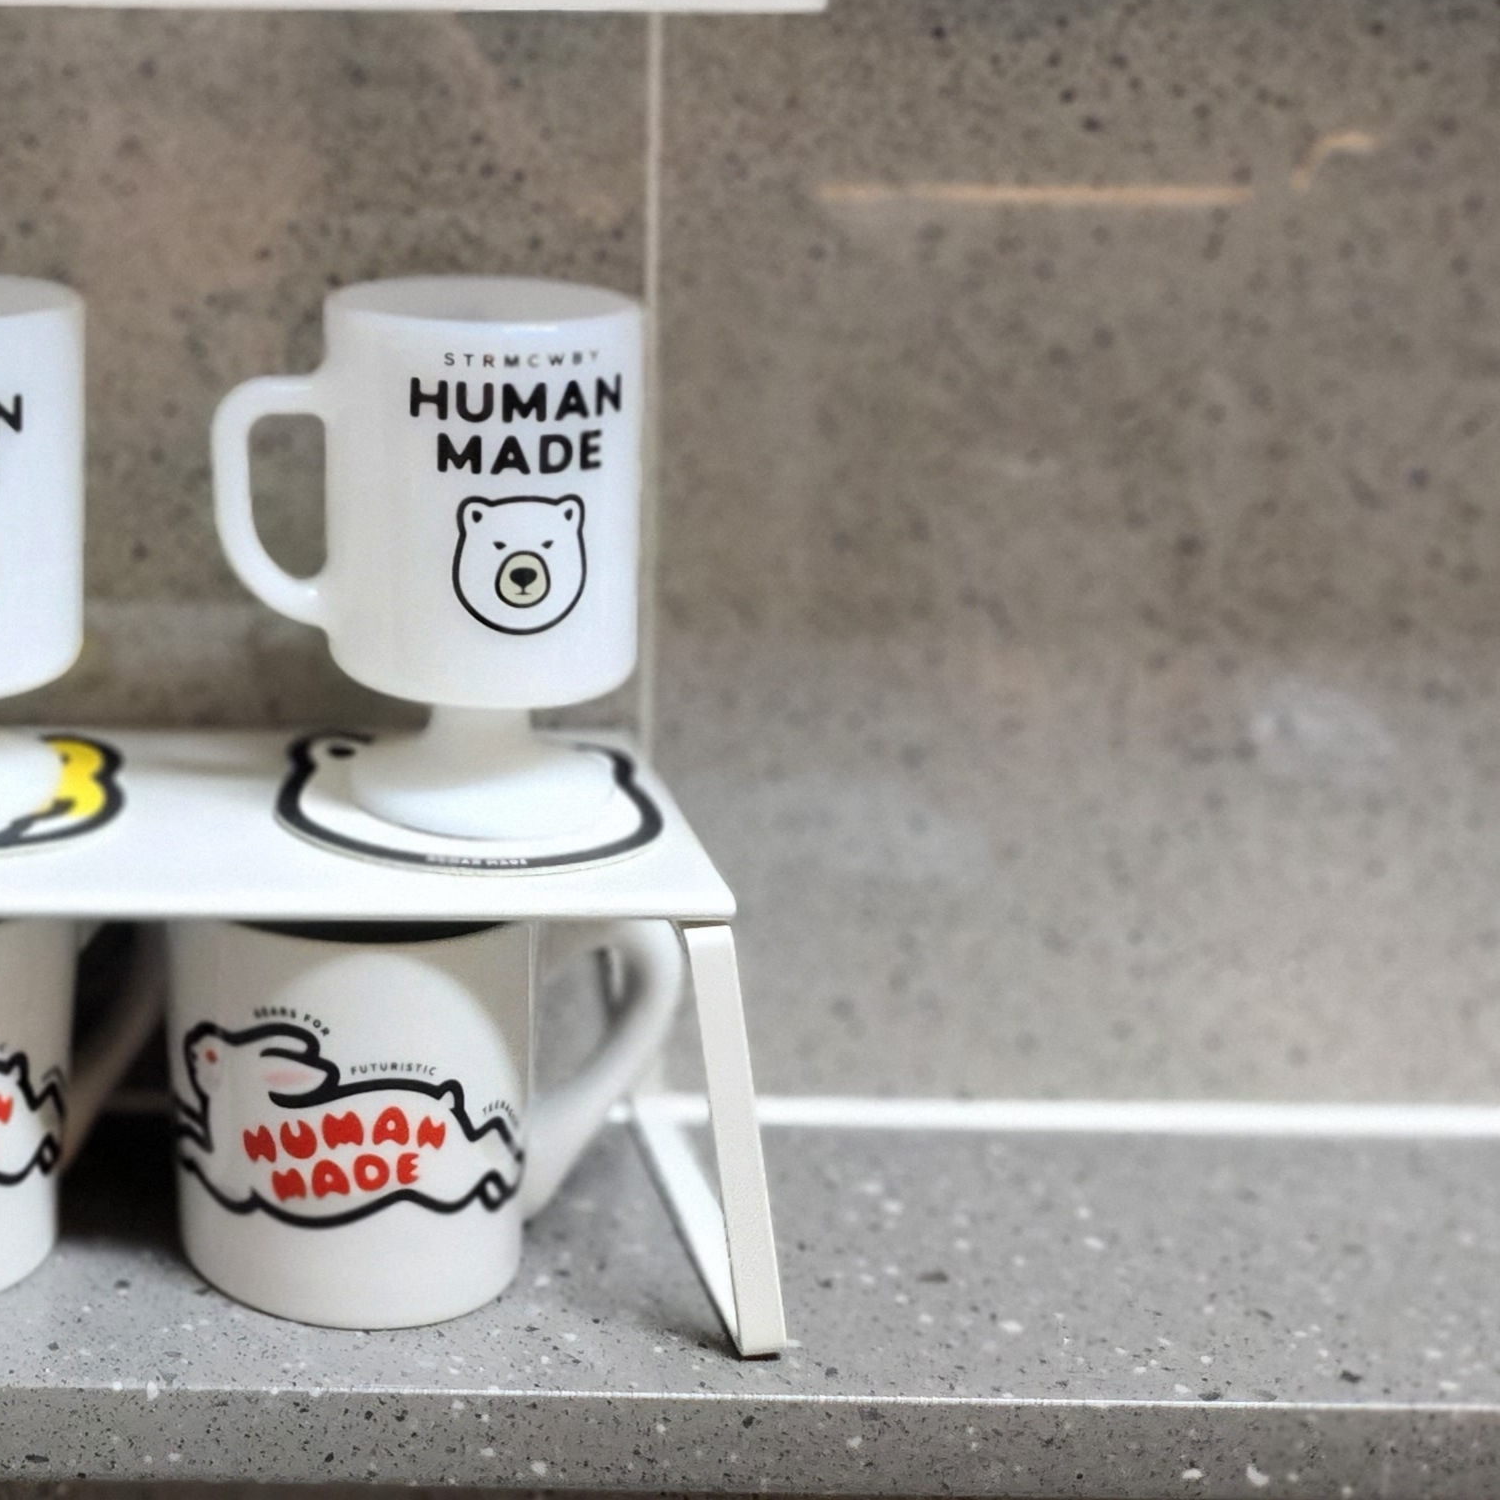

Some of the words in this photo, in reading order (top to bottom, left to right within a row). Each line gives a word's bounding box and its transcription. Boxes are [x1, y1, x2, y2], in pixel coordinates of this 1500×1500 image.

[444, 351, 599, 368] STRMCWBY
[410, 373, 622, 423] HUMAN
[437, 428, 602, 475] MADE
[303, 1013, 331, 1037] FOR
[350, 1062, 437, 1076] FUTURISTIC
[243, 1105, 446, 1163] HUMAN
[271, 1152, 419, 1202] MADE
